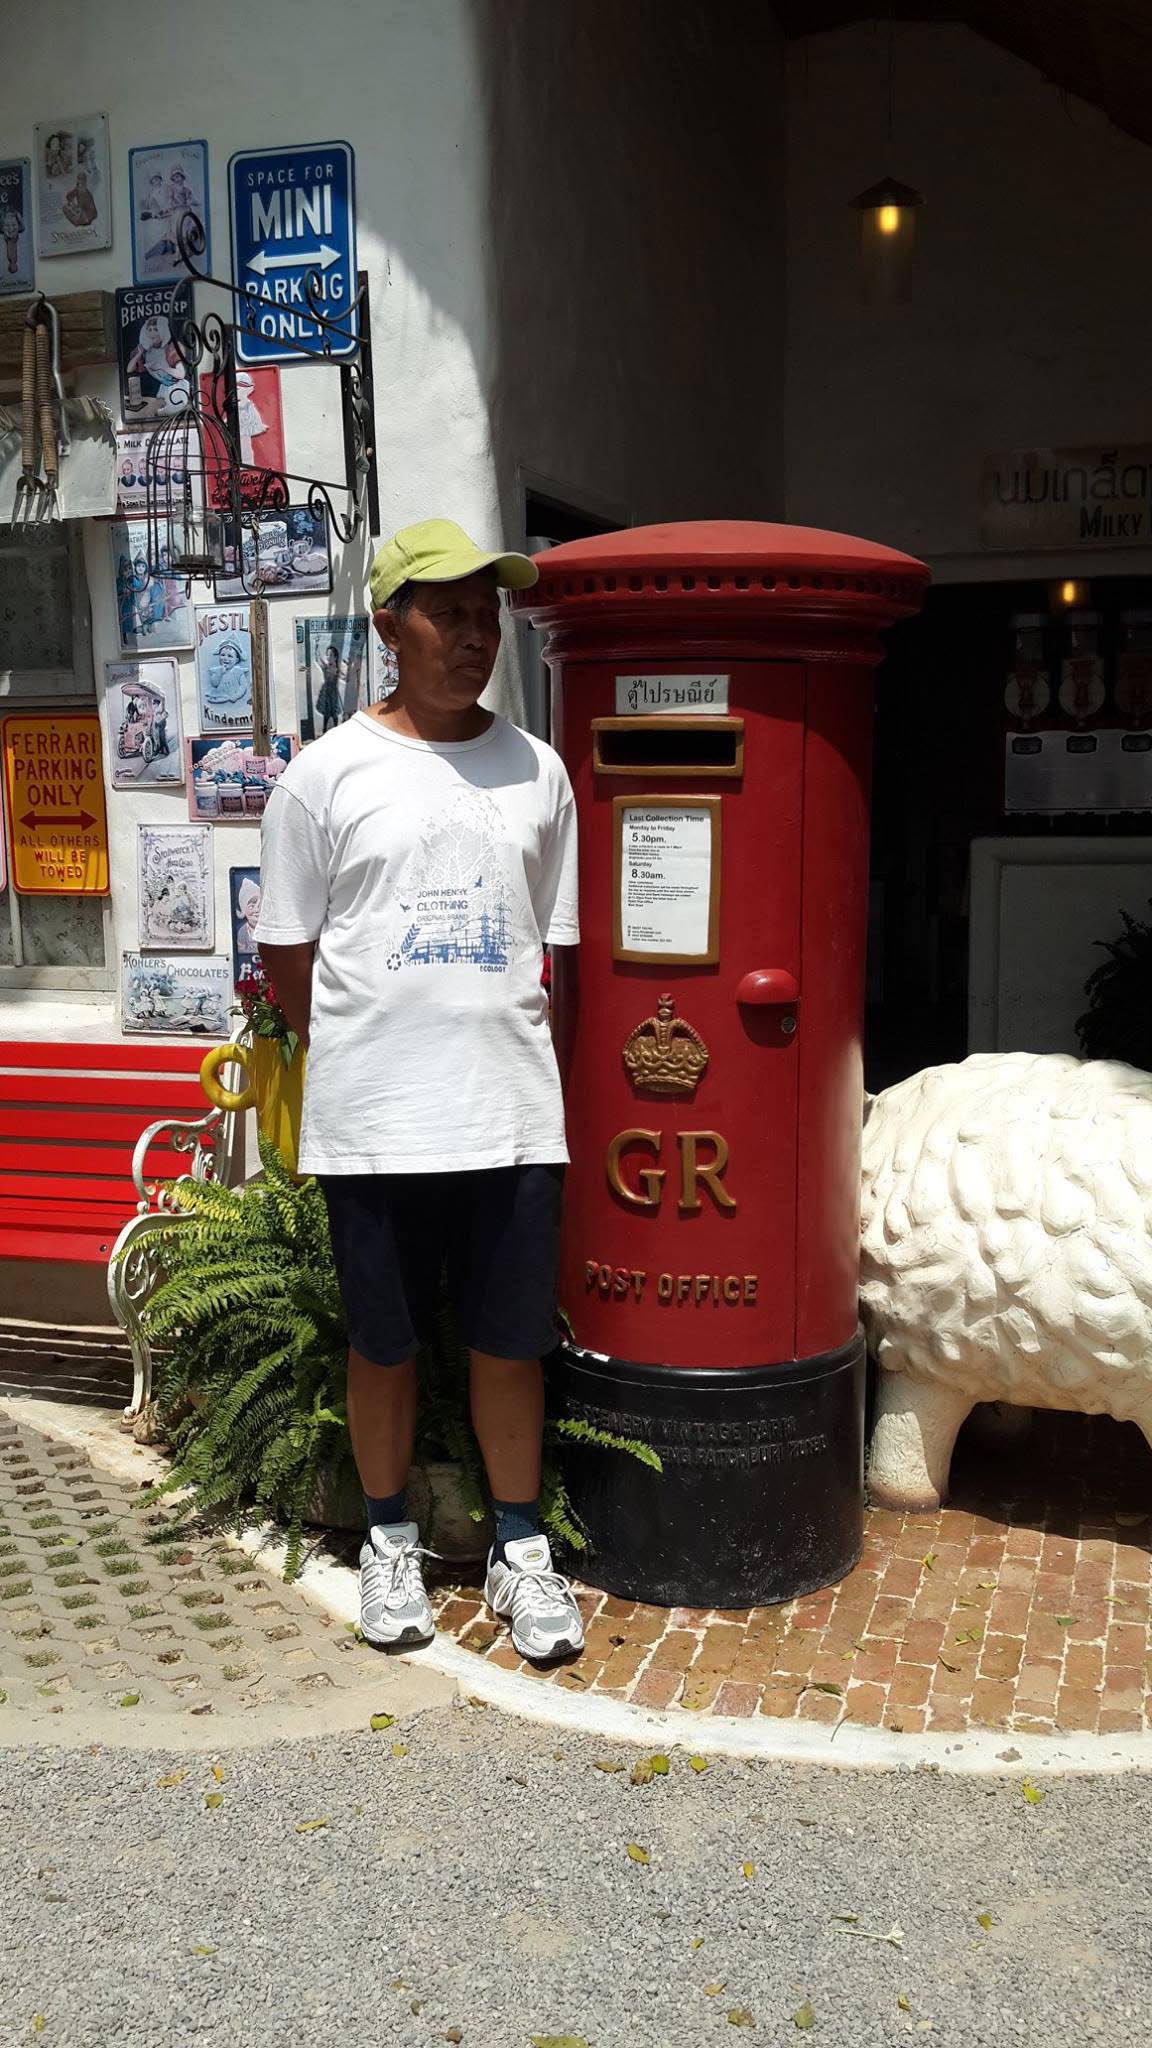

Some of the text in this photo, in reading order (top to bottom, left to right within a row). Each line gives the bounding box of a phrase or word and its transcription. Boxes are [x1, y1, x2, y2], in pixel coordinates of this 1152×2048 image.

[247, 163, 334, 186] SPACE FOR
[251, 184, 333, 242] MINI
[246, 273, 344, 308] PARKNG
[121, 301, 188, 328] BENSDORP
[260, 308, 330, 339] ONLY
[992, 450, 1152, 504] นมเกล็ด
[1080, 505, 1143, 538] MILKY
[197, 612, 249, 646] NESTL
[627, 679, 718, 710] ตู้ไปรษณีย์
[203, 705, 254, 725] Kinderm
[12, 732, 96, 755] FERRARI
[14, 758, 97, 781] PARKING
[27, 784, 85, 806] ONLY
[629, 814, 644, 822] Last
[645, 814, 684, 822] Collection
[20, 835, 100, 847] ALL OTHERS
[34, 849, 87, 863] WILL BE
[40, 865, 83, 879] TOWED
[417, 888, 468, 898] JOHN HENRY
[416, 900, 469, 912] CLOTHING
[416, 913, 469, 922] ORIGINAL BRAND
[166, 964, 229, 978] CHOCOLATES
[480, 965, 506, 973] ECOLOGY
[606, 1127, 737, 1209] GR
[584, 1260, 758, 1301] POST OFFICE
